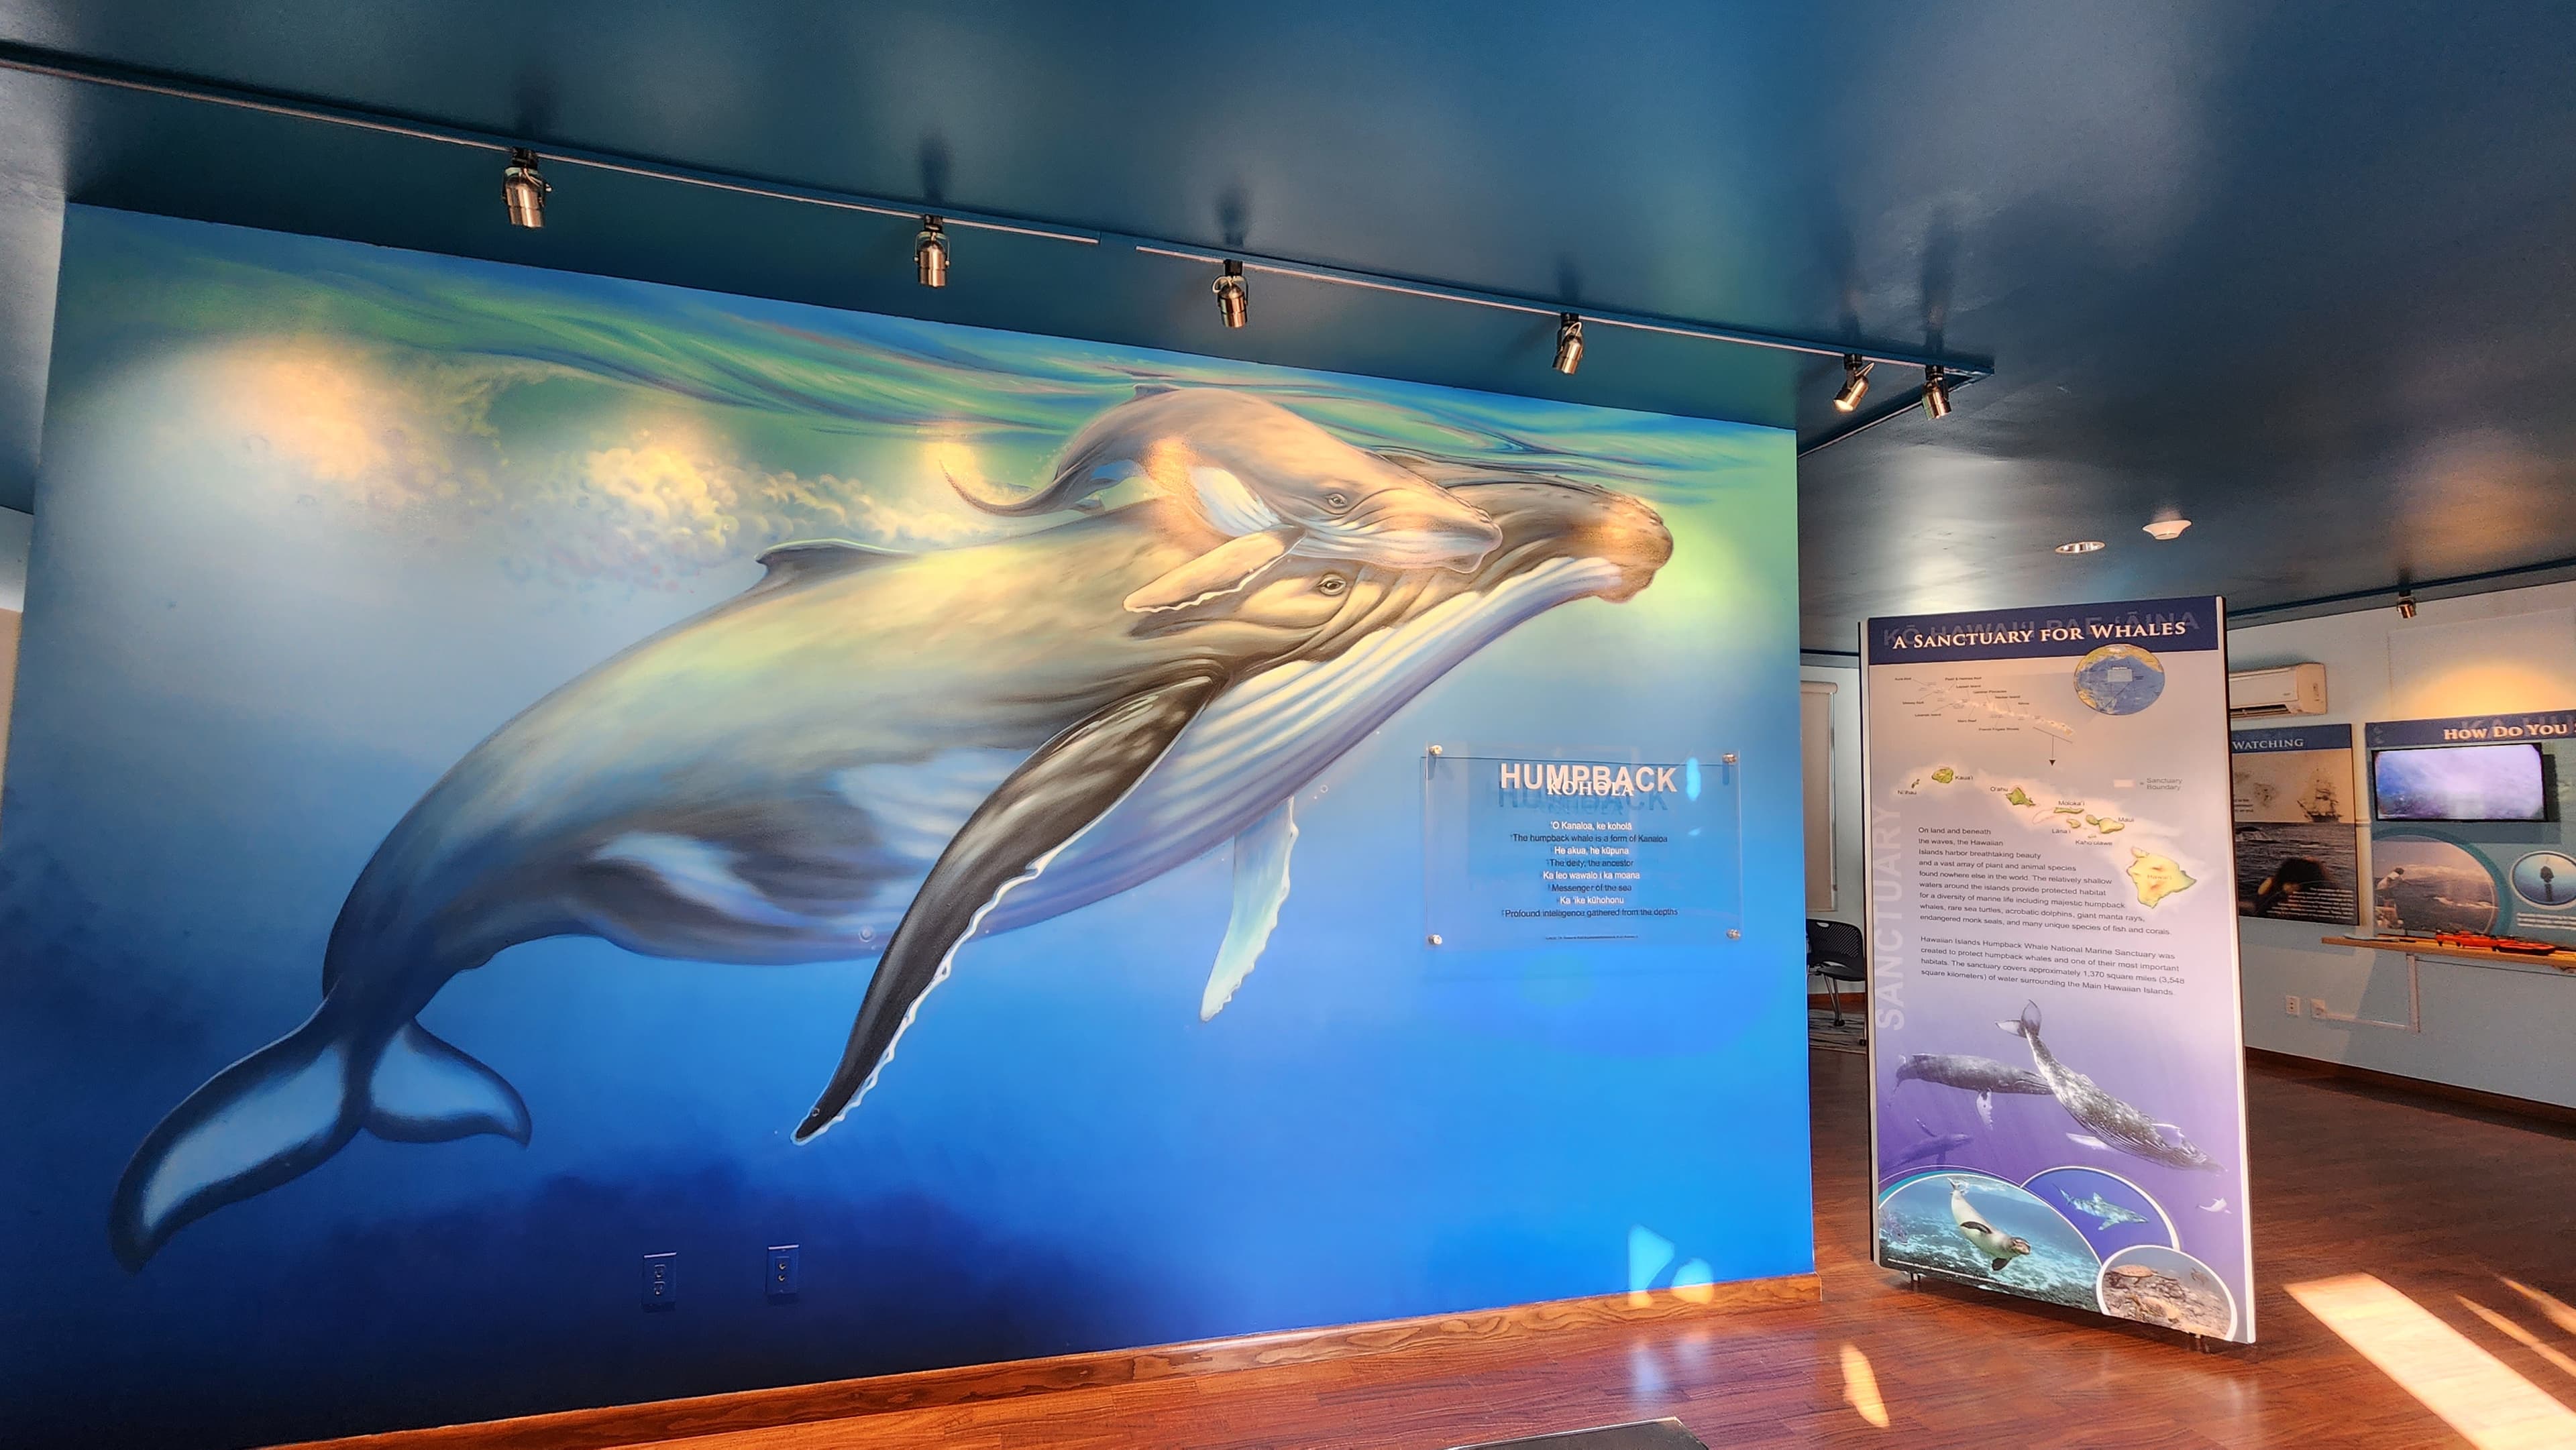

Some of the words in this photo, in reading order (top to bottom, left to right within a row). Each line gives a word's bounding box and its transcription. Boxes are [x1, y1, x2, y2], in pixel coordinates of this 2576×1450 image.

[1892, 636, 1907, 649] A
[1914, 630, 2033, 649] SANCTUARY
[2040, 628, 2084, 641] FOR
[2090, 622, 2186, 638] WHALES
[2443, 728, 2487, 740] HOW
[2493, 726, 2523, 737] DO
[2527, 724, 2567, 735] YOU
[2233, 739, 2304, 749] WATCHING
[1501, 763, 1677, 793] HUMPBACK
[1562, 822, 1595, 830] Kanaloa,
[1597, 822, 1605, 830] ke
[1530, 834, 1568, 843] humpback
[1629, 834, 1637, 842] of
[1554, 846, 1565, 854] He
[1568, 846, 1587, 855] akua,
[1591, 846, 1599, 854] he
[1543, 871, 1554, 879] Ka
[1556, 871, 1567, 879] leo
[1604, 871, 1613, 879] ka
[2049, 876, 2080, 884] relatively
[1552, 885, 1594, 893] Messenger
[2041, 887, 2077, 895] protected
[2016, 897, 2049, 905] including
[1587, 909, 1619, 917] gathered
[2041, 909, 2075, 918] dolphins,
[1873, 805, 1905, 1031] SANCTUARY
[1982, 940, 2022, 949] Humpback
[2115, 950, 2156, 959] Sanctuary
[1985, 952, 2023, 960] humpback
[2141, 963, 2179, 972] important
[1967, 962, 2000, 970] sanctuary
[2029, 966, 2080, 977] approximately
[1947, 971, 1986, 981] kilometers)
[2021, 977, 2065, 987] surrounding
[2104, 984, 2141, 993] Hawaiian
